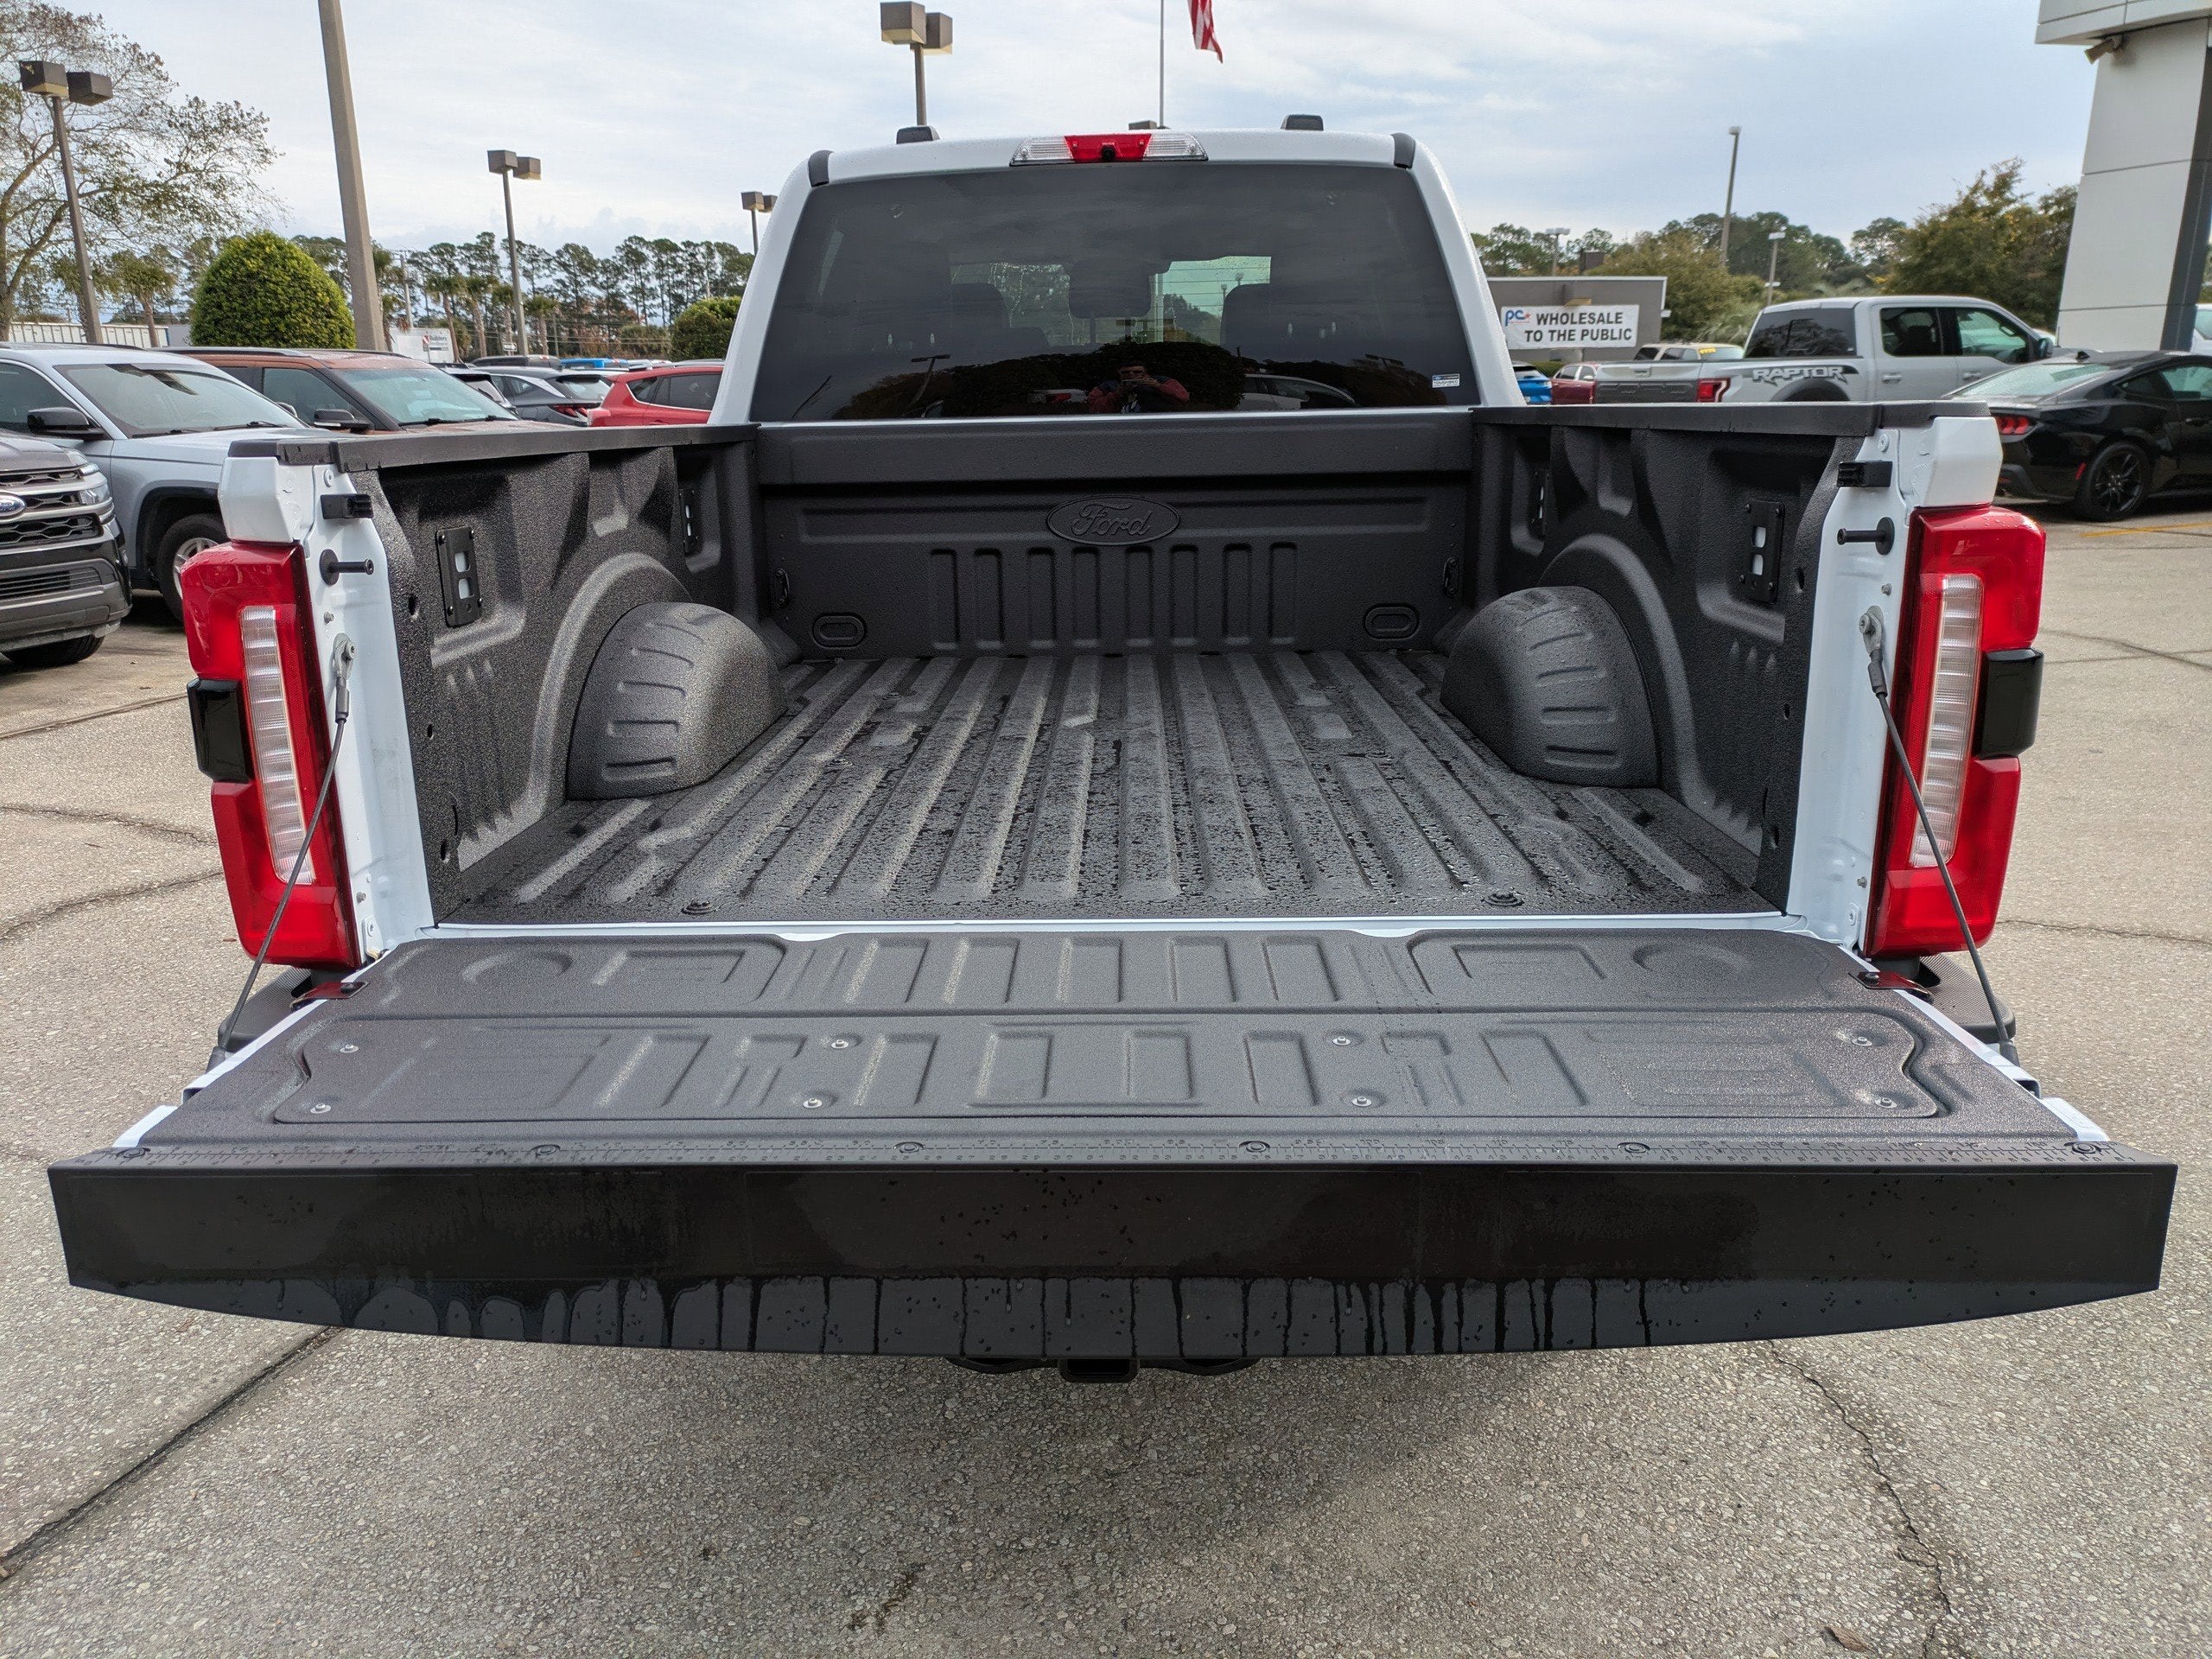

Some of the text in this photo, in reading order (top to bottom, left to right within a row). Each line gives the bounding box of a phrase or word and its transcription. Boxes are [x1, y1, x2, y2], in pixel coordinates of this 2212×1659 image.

[1536, 312, 1624, 326] WHOLESALE
[1524, 327, 1632, 342] TO THE PUBLIC
[1753, 366, 1847, 386] RAPTOR
[1071, 501, 1154, 537] Ford
